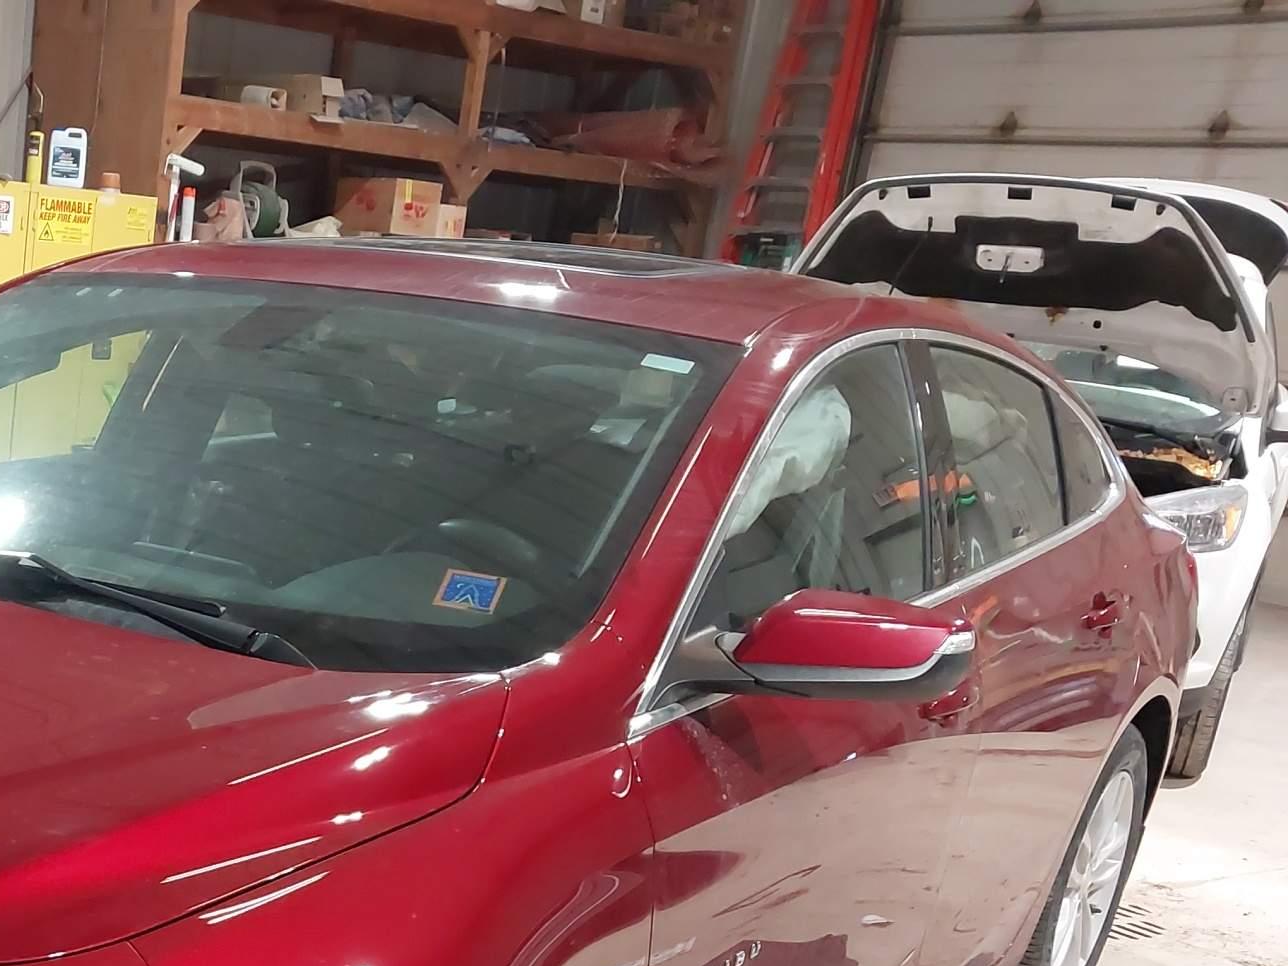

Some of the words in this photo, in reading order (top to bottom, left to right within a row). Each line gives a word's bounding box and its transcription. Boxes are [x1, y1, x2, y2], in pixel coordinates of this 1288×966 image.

[40, 198, 93, 214] FLAMMABLE
[39, 211, 57, 221] KEEP
[57, 213, 72, 223] FIRE
[72, 215, 91, 224] AWAY
